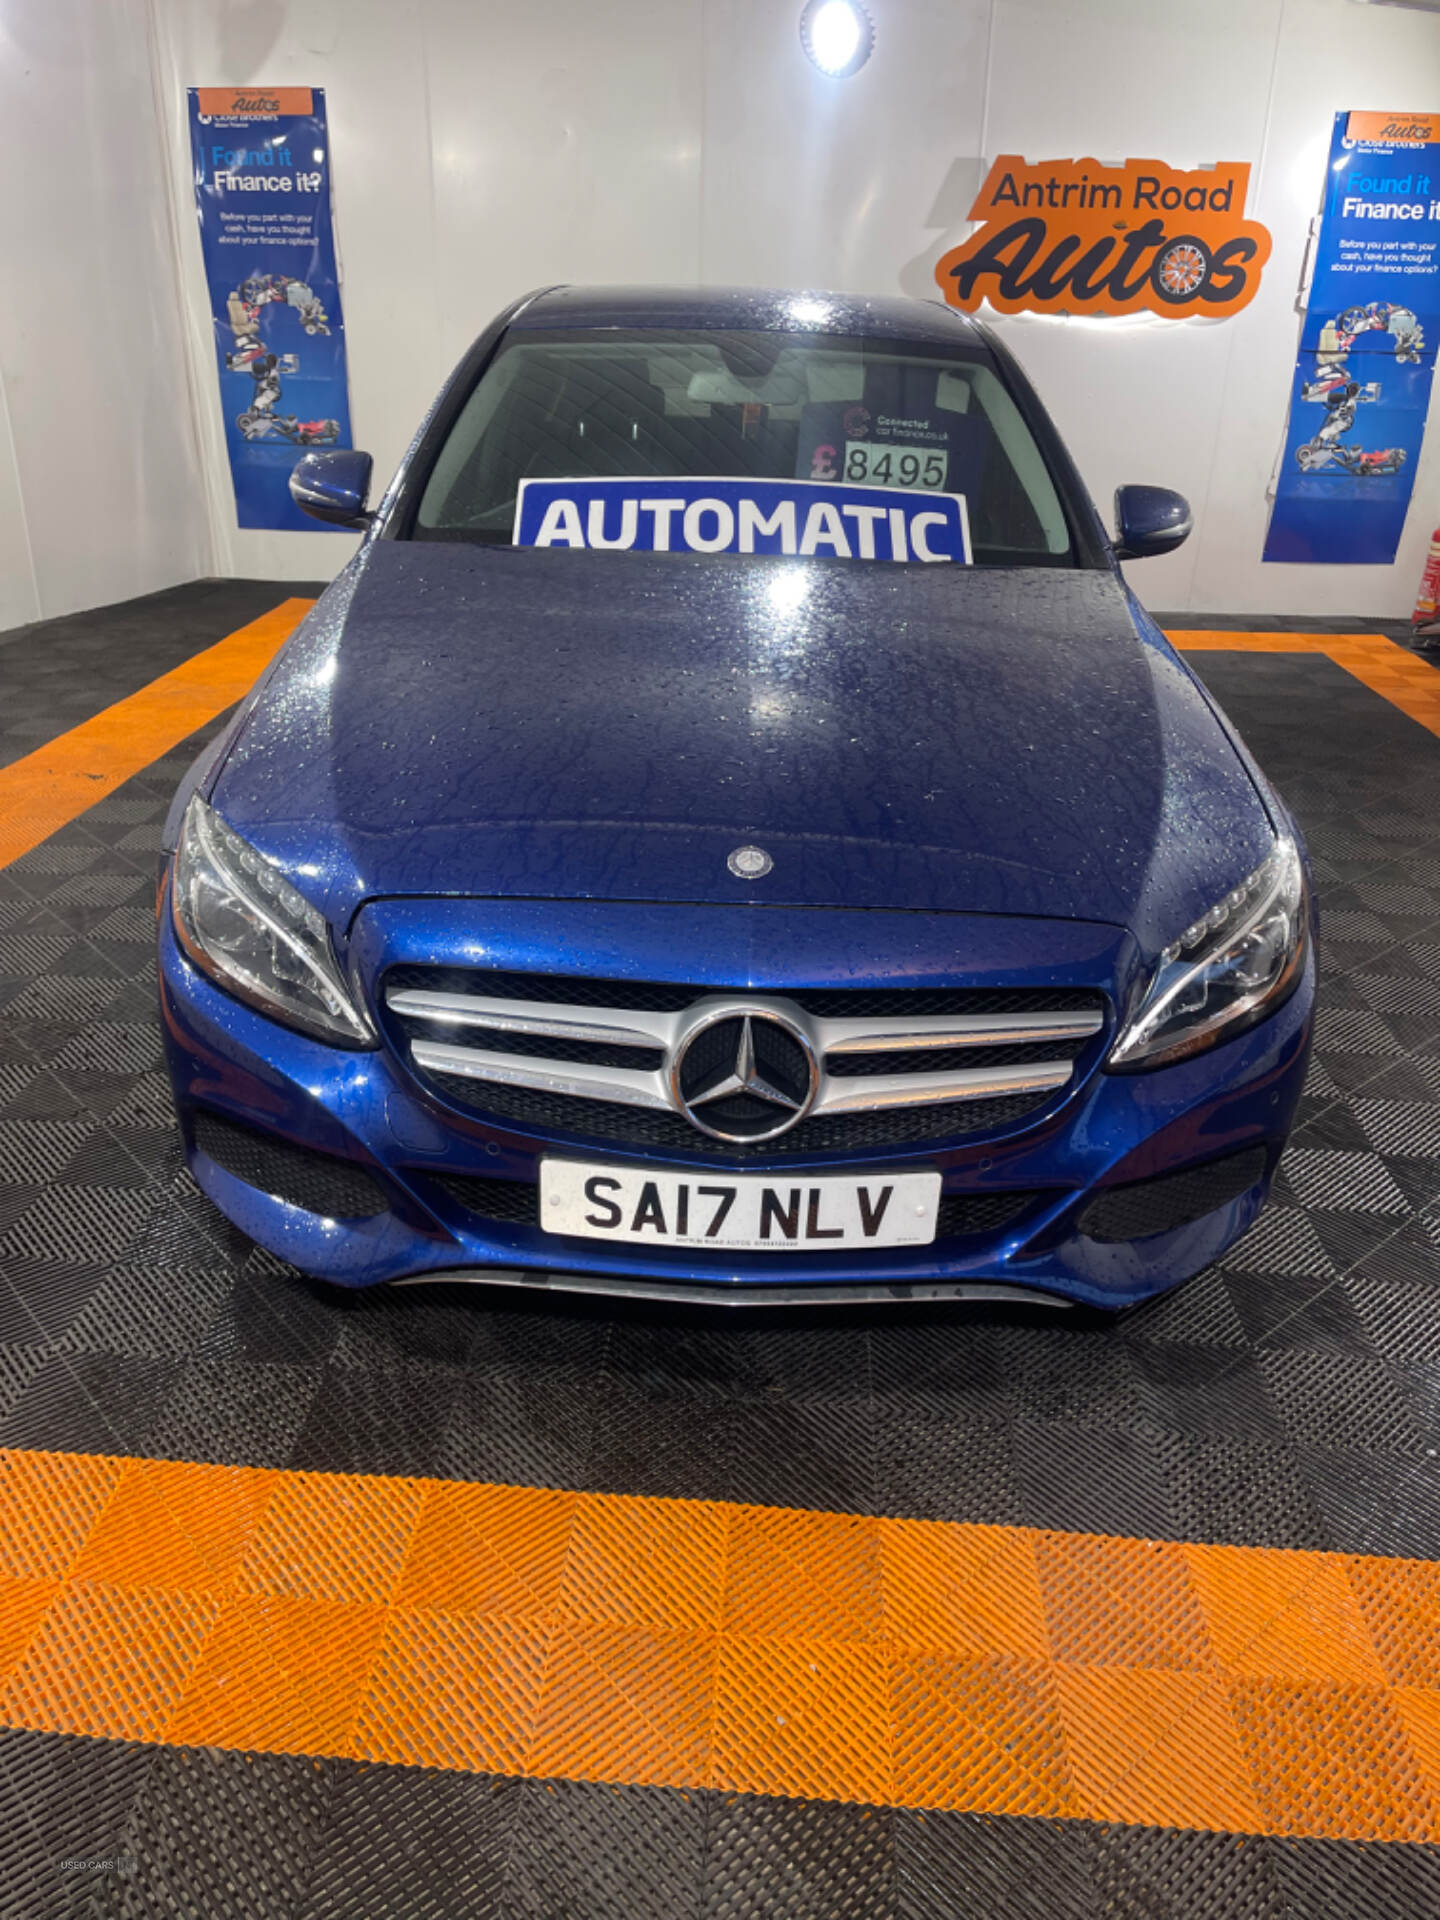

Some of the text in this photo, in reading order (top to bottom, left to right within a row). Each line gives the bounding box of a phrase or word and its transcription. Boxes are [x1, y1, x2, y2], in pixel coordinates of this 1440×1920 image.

[232, 98, 280, 112] Autos
[1380, 123, 1432, 139] Autos
[212, 146, 292, 166] Found it
[214, 171, 322, 192] Finance it?
[1347, 172, 1431, 195] Found it
[991, 173, 1233, 212] Antrim Road
[1342, 198, 1424, 220] Finance
[1367, 241, 1381, 250] you
[1418, 243, 1437, 252] your
[950, 217, 1258, 304] Autos
[1384, 254, 1398, 263] you
[1400, 253, 1431, 263] thought
[1354, 264, 1372, 273] your
[877, 415, 929, 429] Connected
[534, 498, 952, 562] AUTOMATIC
[584, 1176, 894, 1239] SA17 NLV
